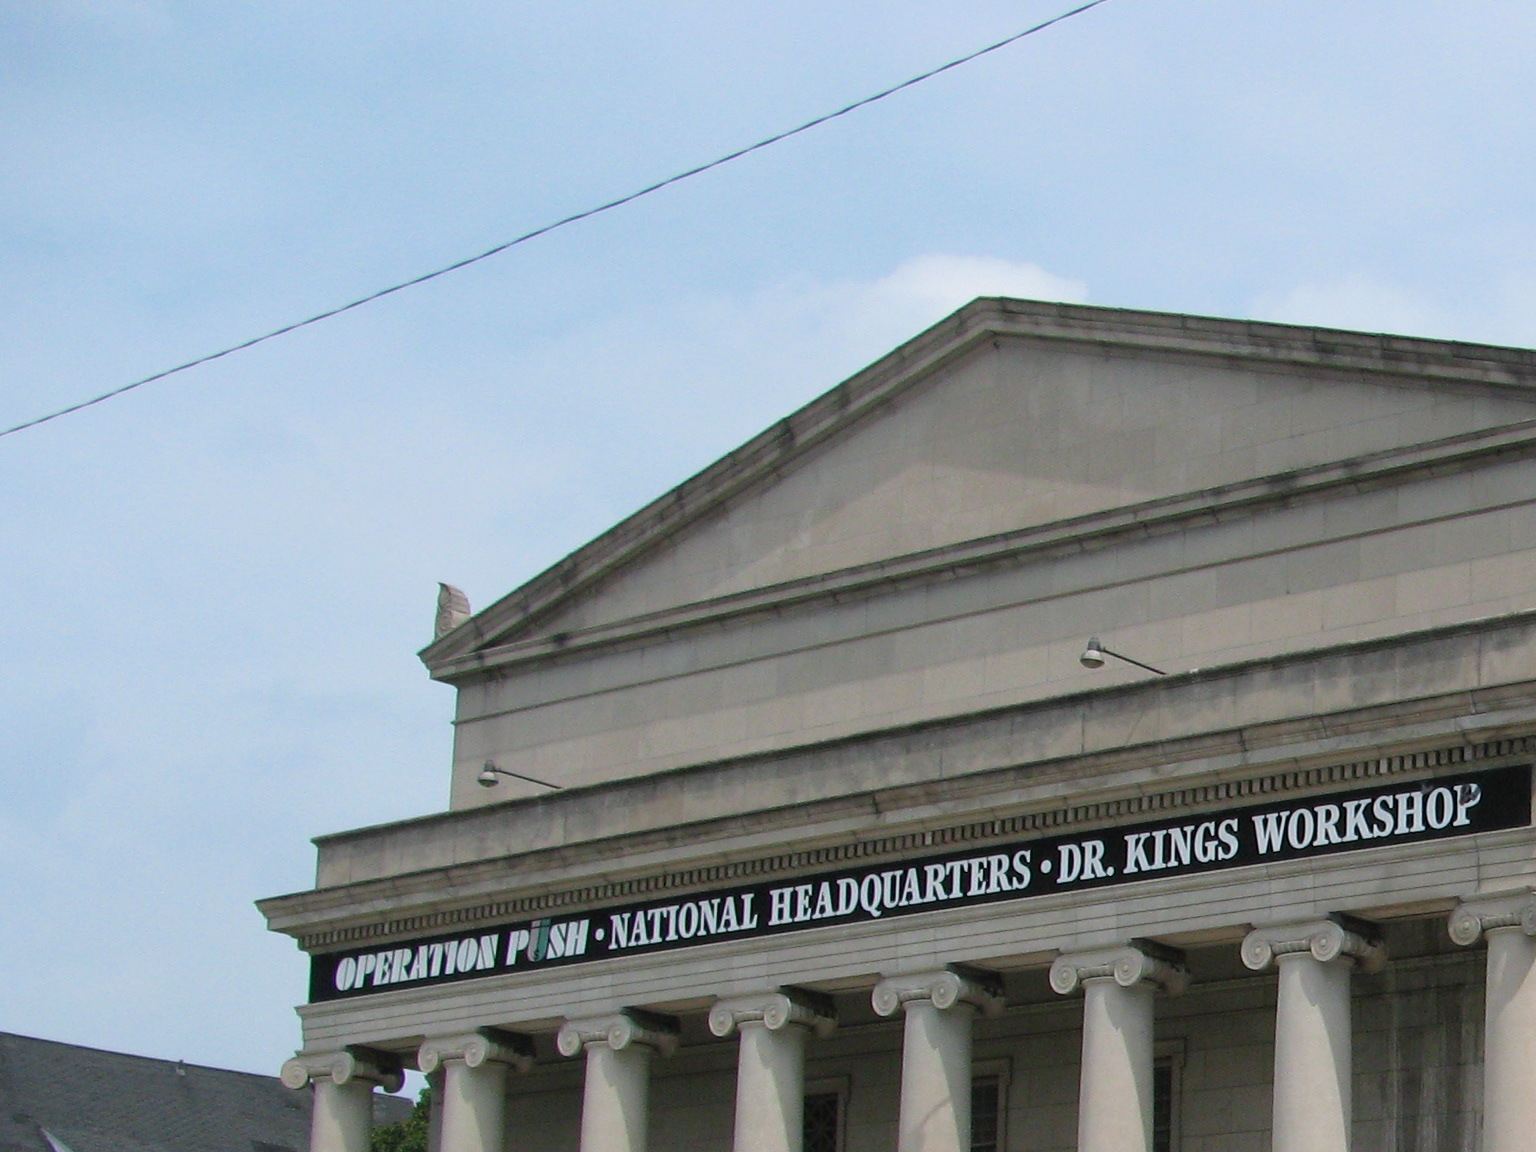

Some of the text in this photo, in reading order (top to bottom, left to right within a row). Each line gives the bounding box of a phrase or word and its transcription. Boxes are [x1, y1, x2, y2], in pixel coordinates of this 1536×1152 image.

[335, 783, 1482, 991] OPERATION PUSH NATIONAL HEADQUARTERS DR. KINGS WORKSHOP
